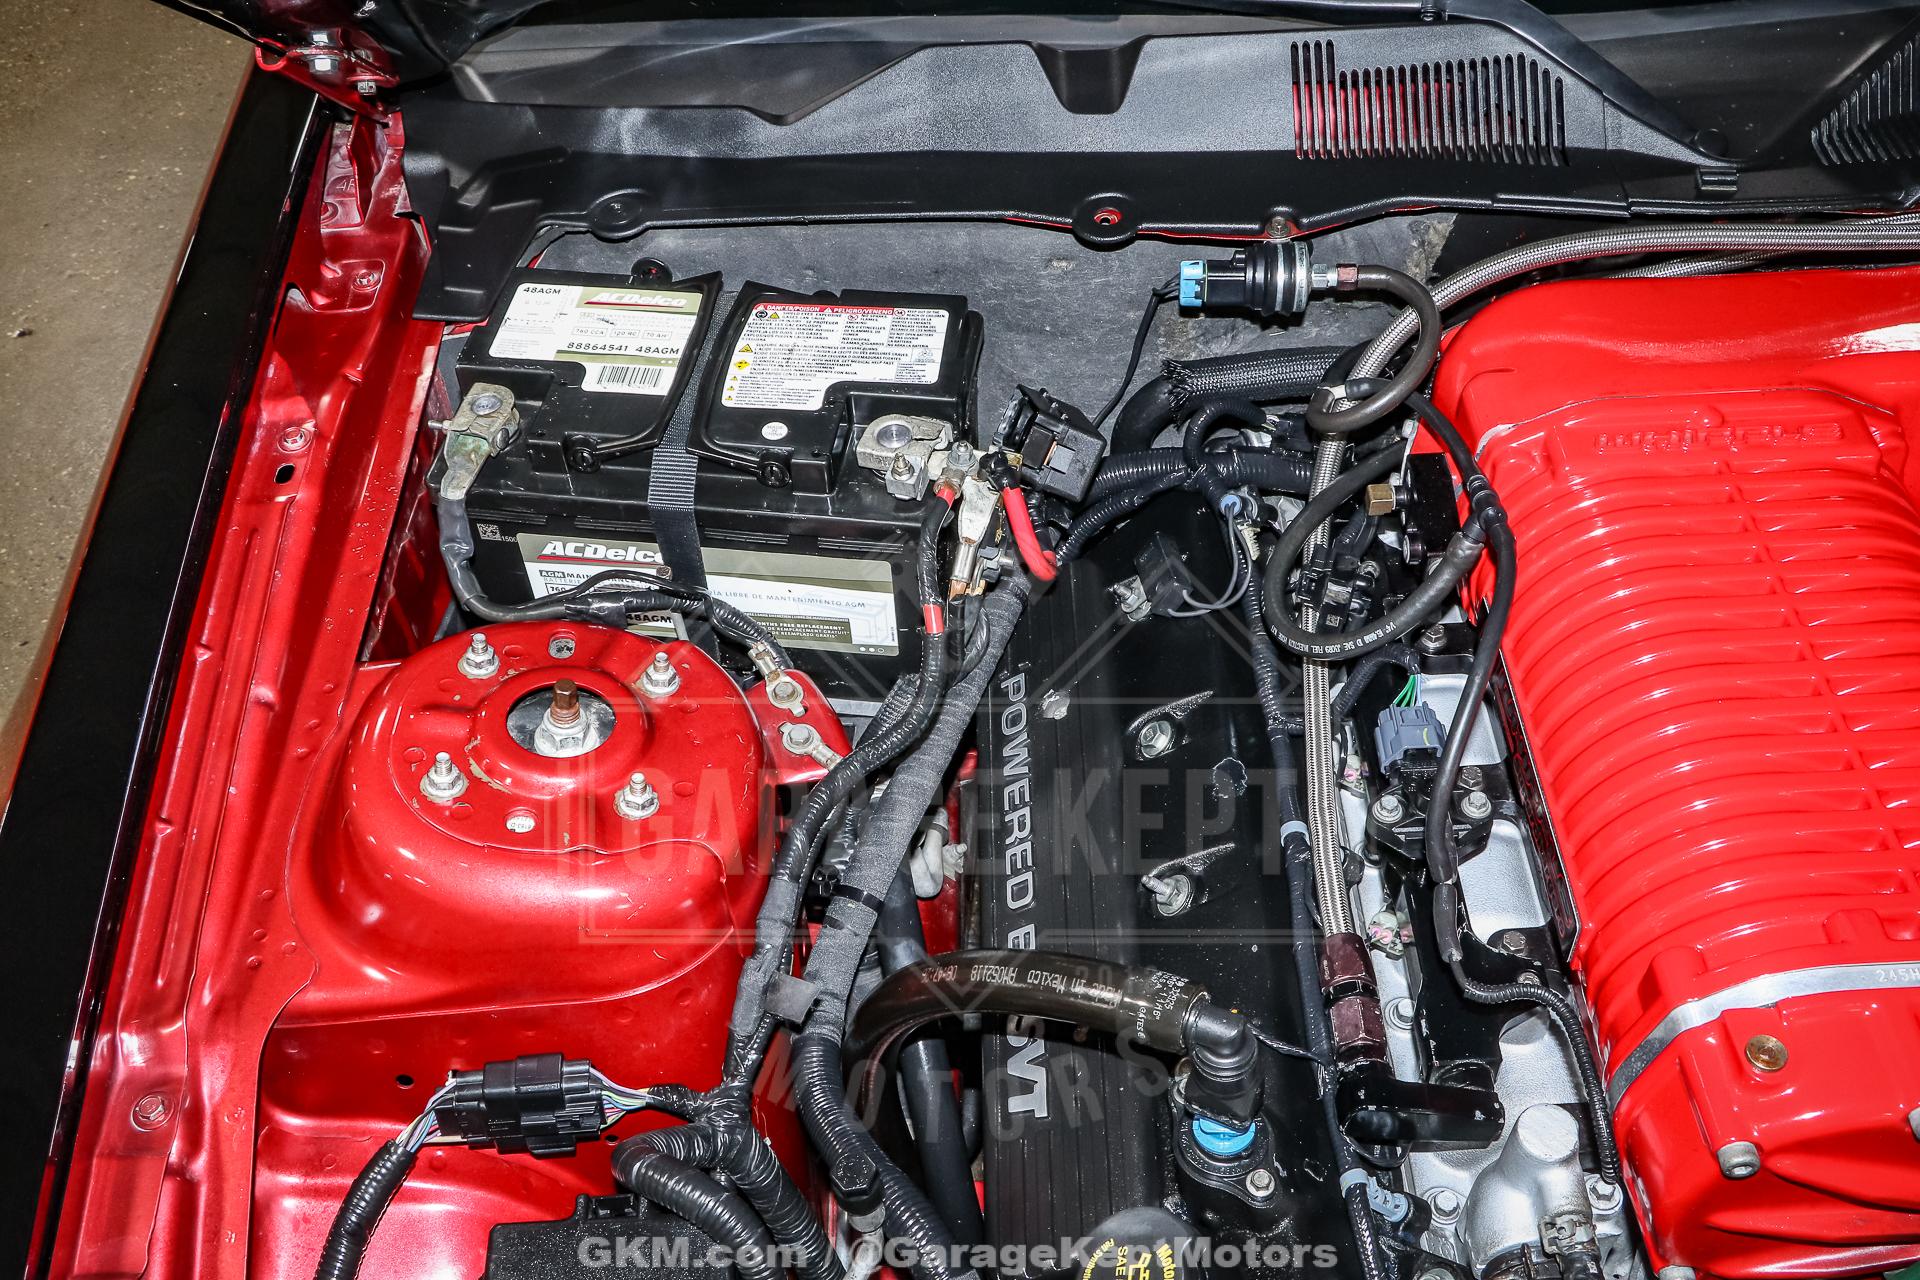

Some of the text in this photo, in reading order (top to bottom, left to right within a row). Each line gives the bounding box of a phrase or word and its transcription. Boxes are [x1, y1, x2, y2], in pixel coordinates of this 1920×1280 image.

[523, 286, 561, 295] 48AGM
[590, 291, 688, 306] ACDelco
[833, 307, 893, 315] PELIGRO/VENENO
[567, 342, 680, 355] 88864541 48AGM
[540, 570, 565, 578] AGM
[725, 591, 749, 599] LIBRE
[766, 594, 842, 607] MANTENIMIENTO
[844, 601, 866, 609] AGM
[626, 613, 672, 624] 48AGM
[1001, 672, 1034, 911] POWERED
[1026, 969, 1067, 994] Mexico
[1006, 1014, 1048, 1118] SVT
[1116, 1245, 1129, 1277] SAE
[1155, 1243, 1176, 1280] Moto
